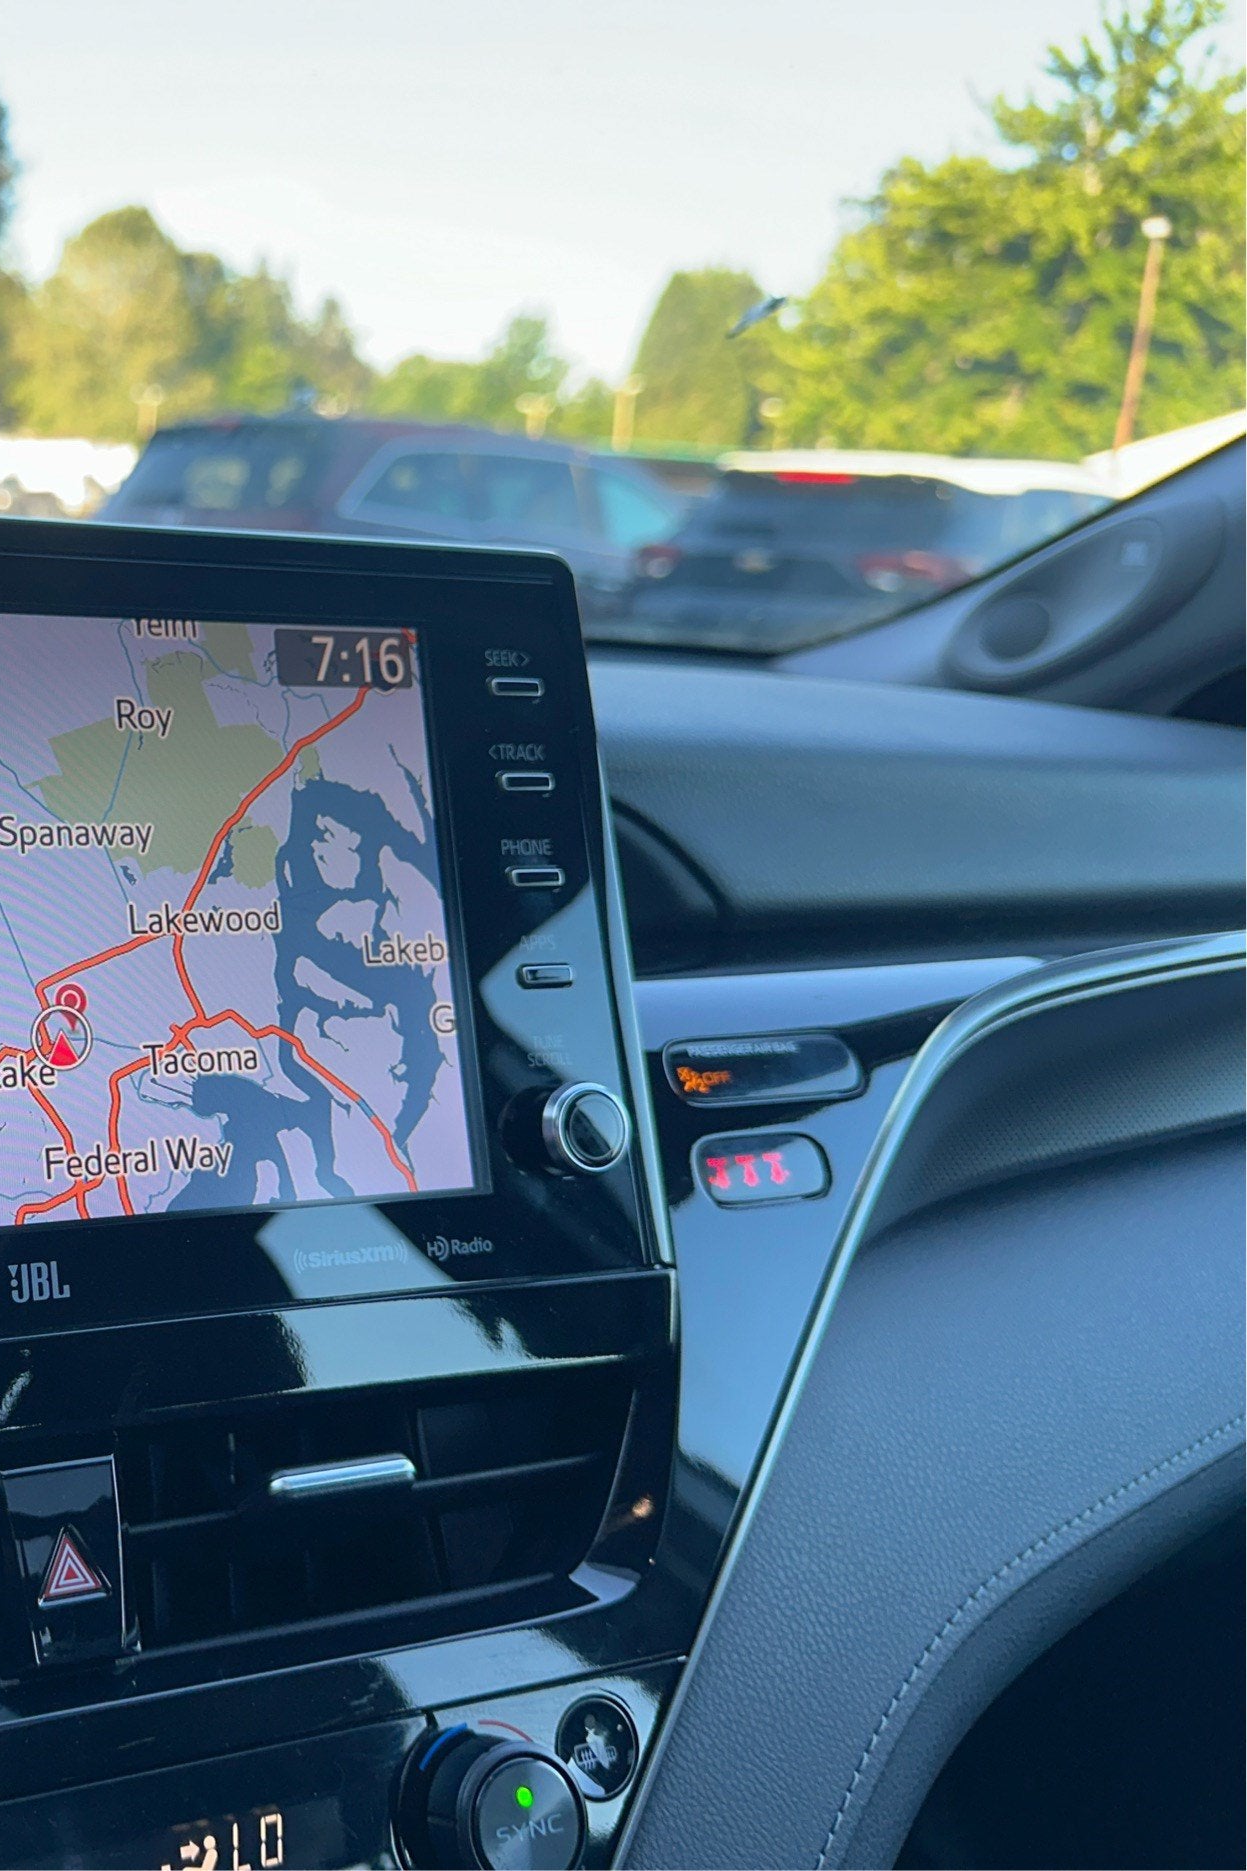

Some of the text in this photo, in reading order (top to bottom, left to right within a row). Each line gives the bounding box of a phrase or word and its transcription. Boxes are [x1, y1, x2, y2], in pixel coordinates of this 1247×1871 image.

[311, 635, 404, 684] 7:16
[116, 700, 172, 737] Roy
[500, 838, 552, 856] PHONE
[128, 902, 281, 934] Lakewood
[363, 935, 444, 965] Lakeb
[142, 1045, 258, 1074] Tacoma
[45, 1138, 231, 1178] Federal Way
[452, 1237, 494, 1256] Radio
[9, 1261, 71, 1304] JBL
[495, 1812, 564, 1843] SYNC
